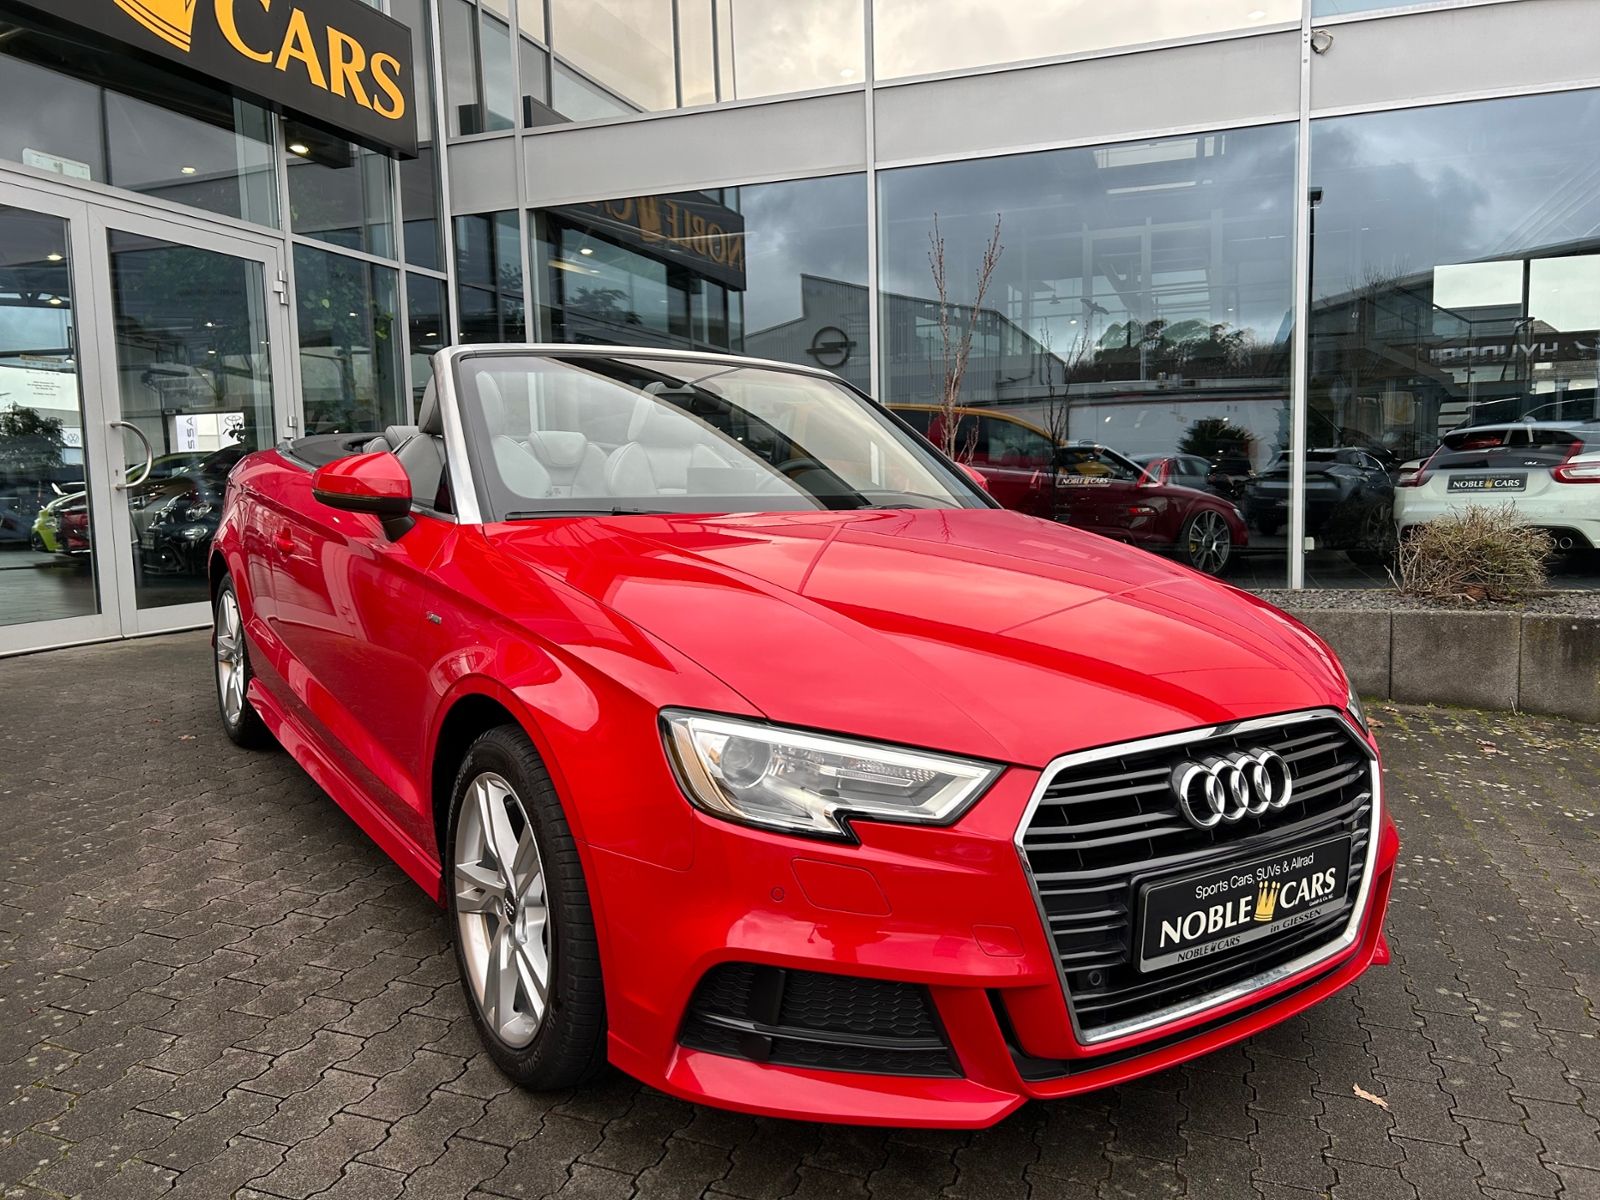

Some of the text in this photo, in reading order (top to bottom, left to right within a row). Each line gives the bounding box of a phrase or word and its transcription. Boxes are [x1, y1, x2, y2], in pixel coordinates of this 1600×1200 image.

[213, 0, 405, 120] CARS
[1452, 479, 1520, 488] NOBLE CARS
[1195, 852, 1314, 900] Sports Cars, SUVs & Allrad
[1159, 867, 1336, 948] NOBLE CARS
[1270, 908, 1322, 933] in GIESSEN
[1177, 936, 1241, 962] NOBLE CARS
